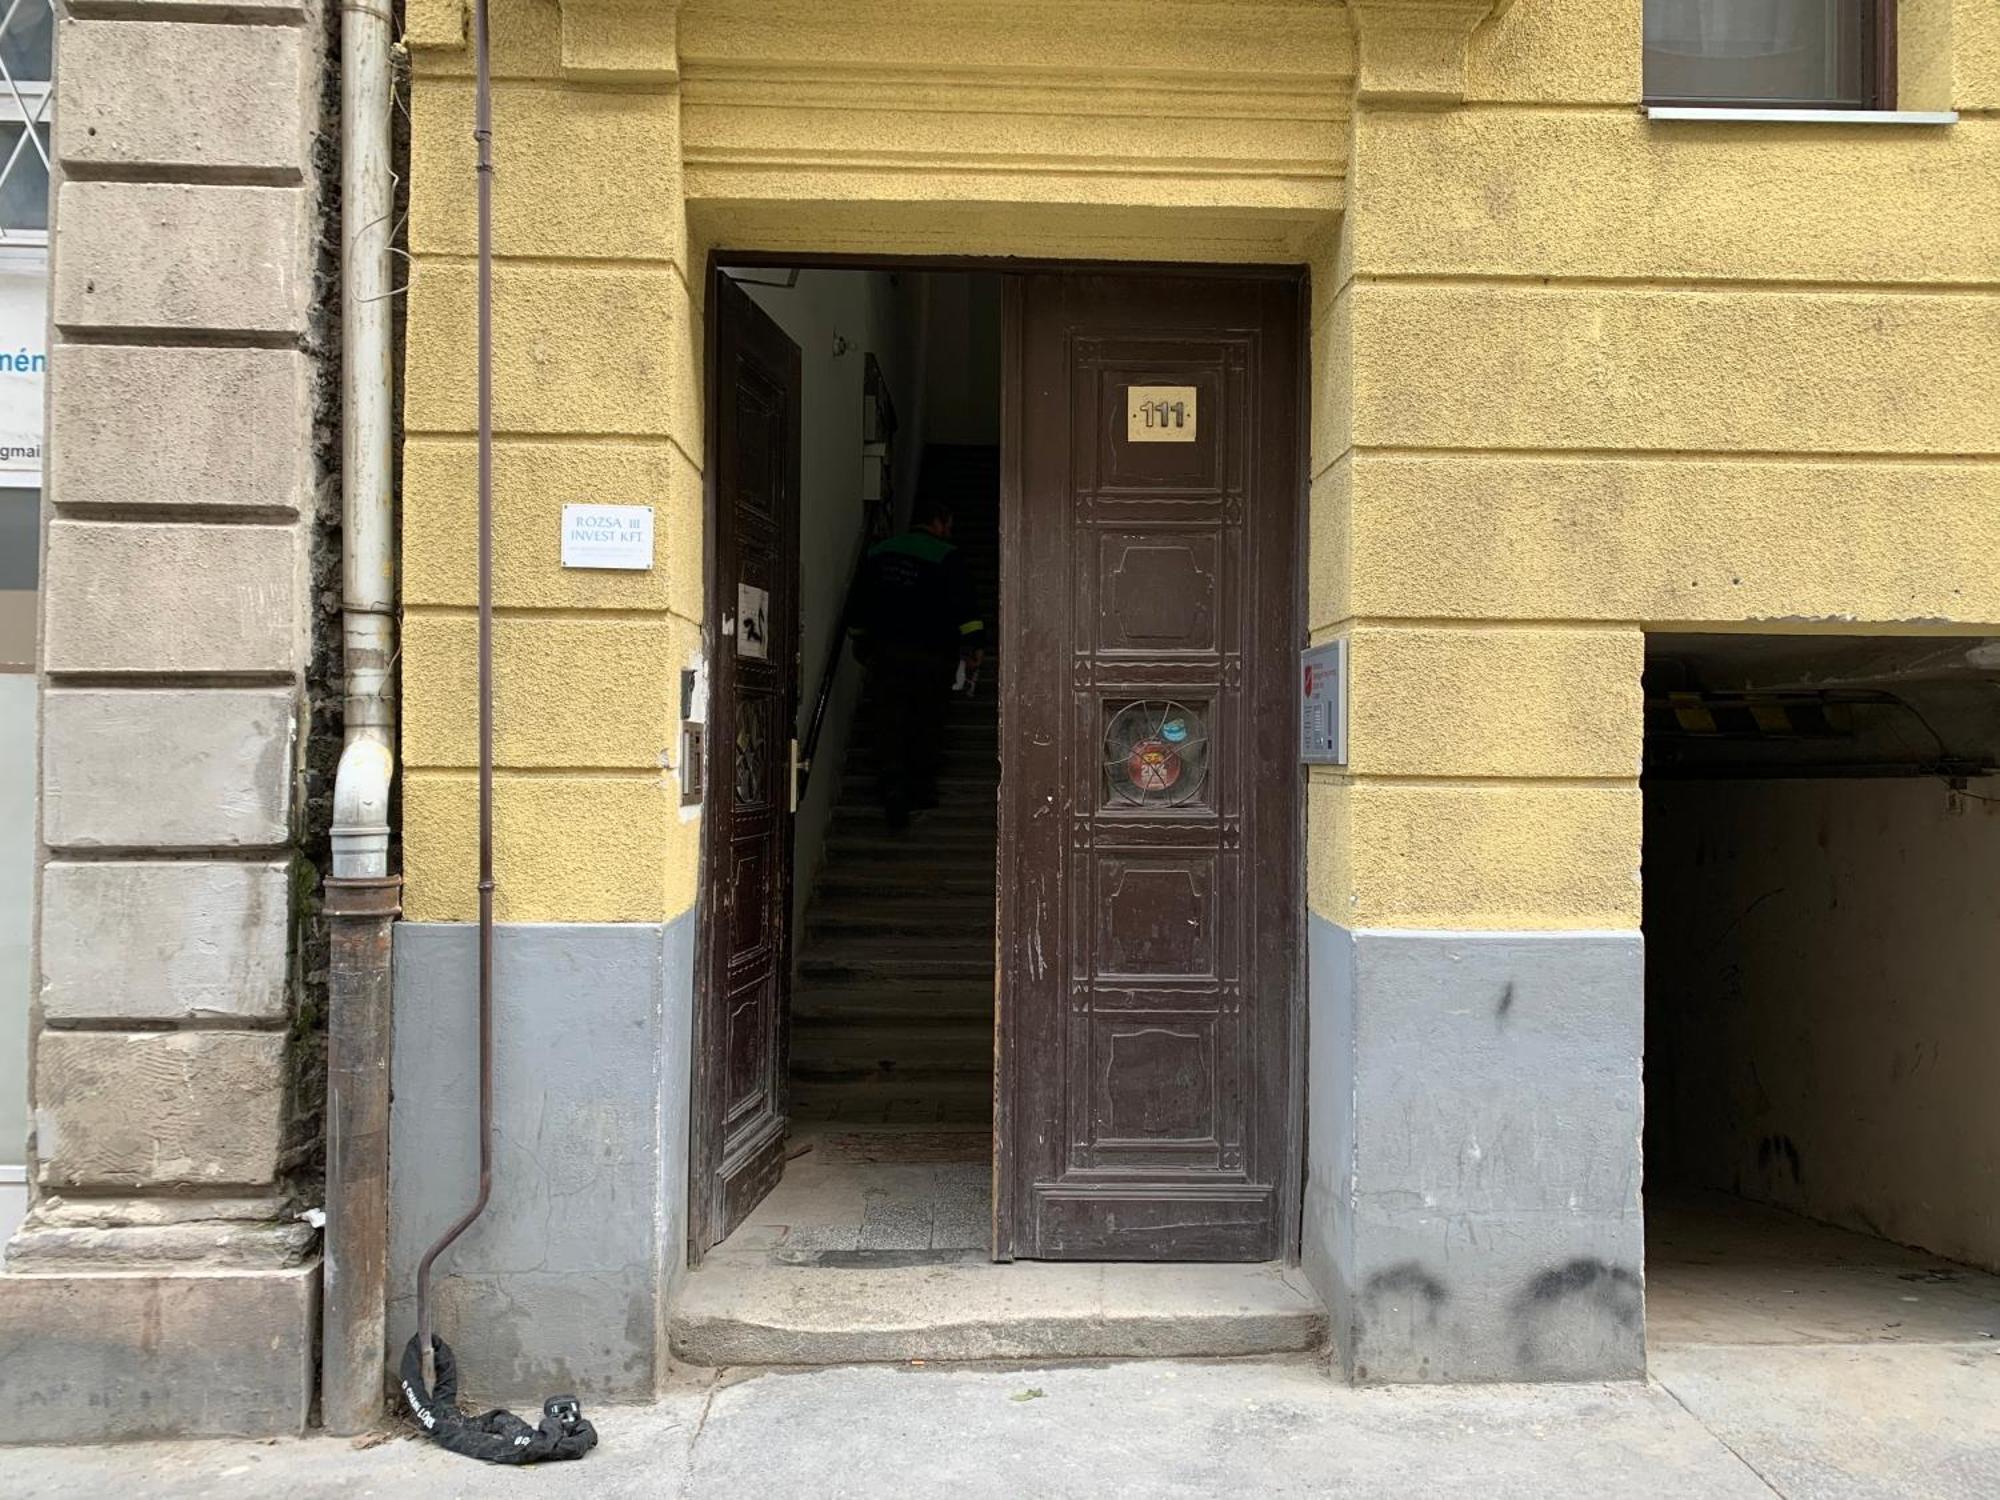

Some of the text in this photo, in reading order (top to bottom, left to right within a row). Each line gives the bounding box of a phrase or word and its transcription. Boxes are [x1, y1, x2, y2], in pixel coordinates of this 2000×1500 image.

[1140, 400, 1184, 428] 111
[629, 518, 641, 529] III
[571, 529, 615, 543] INVEST
